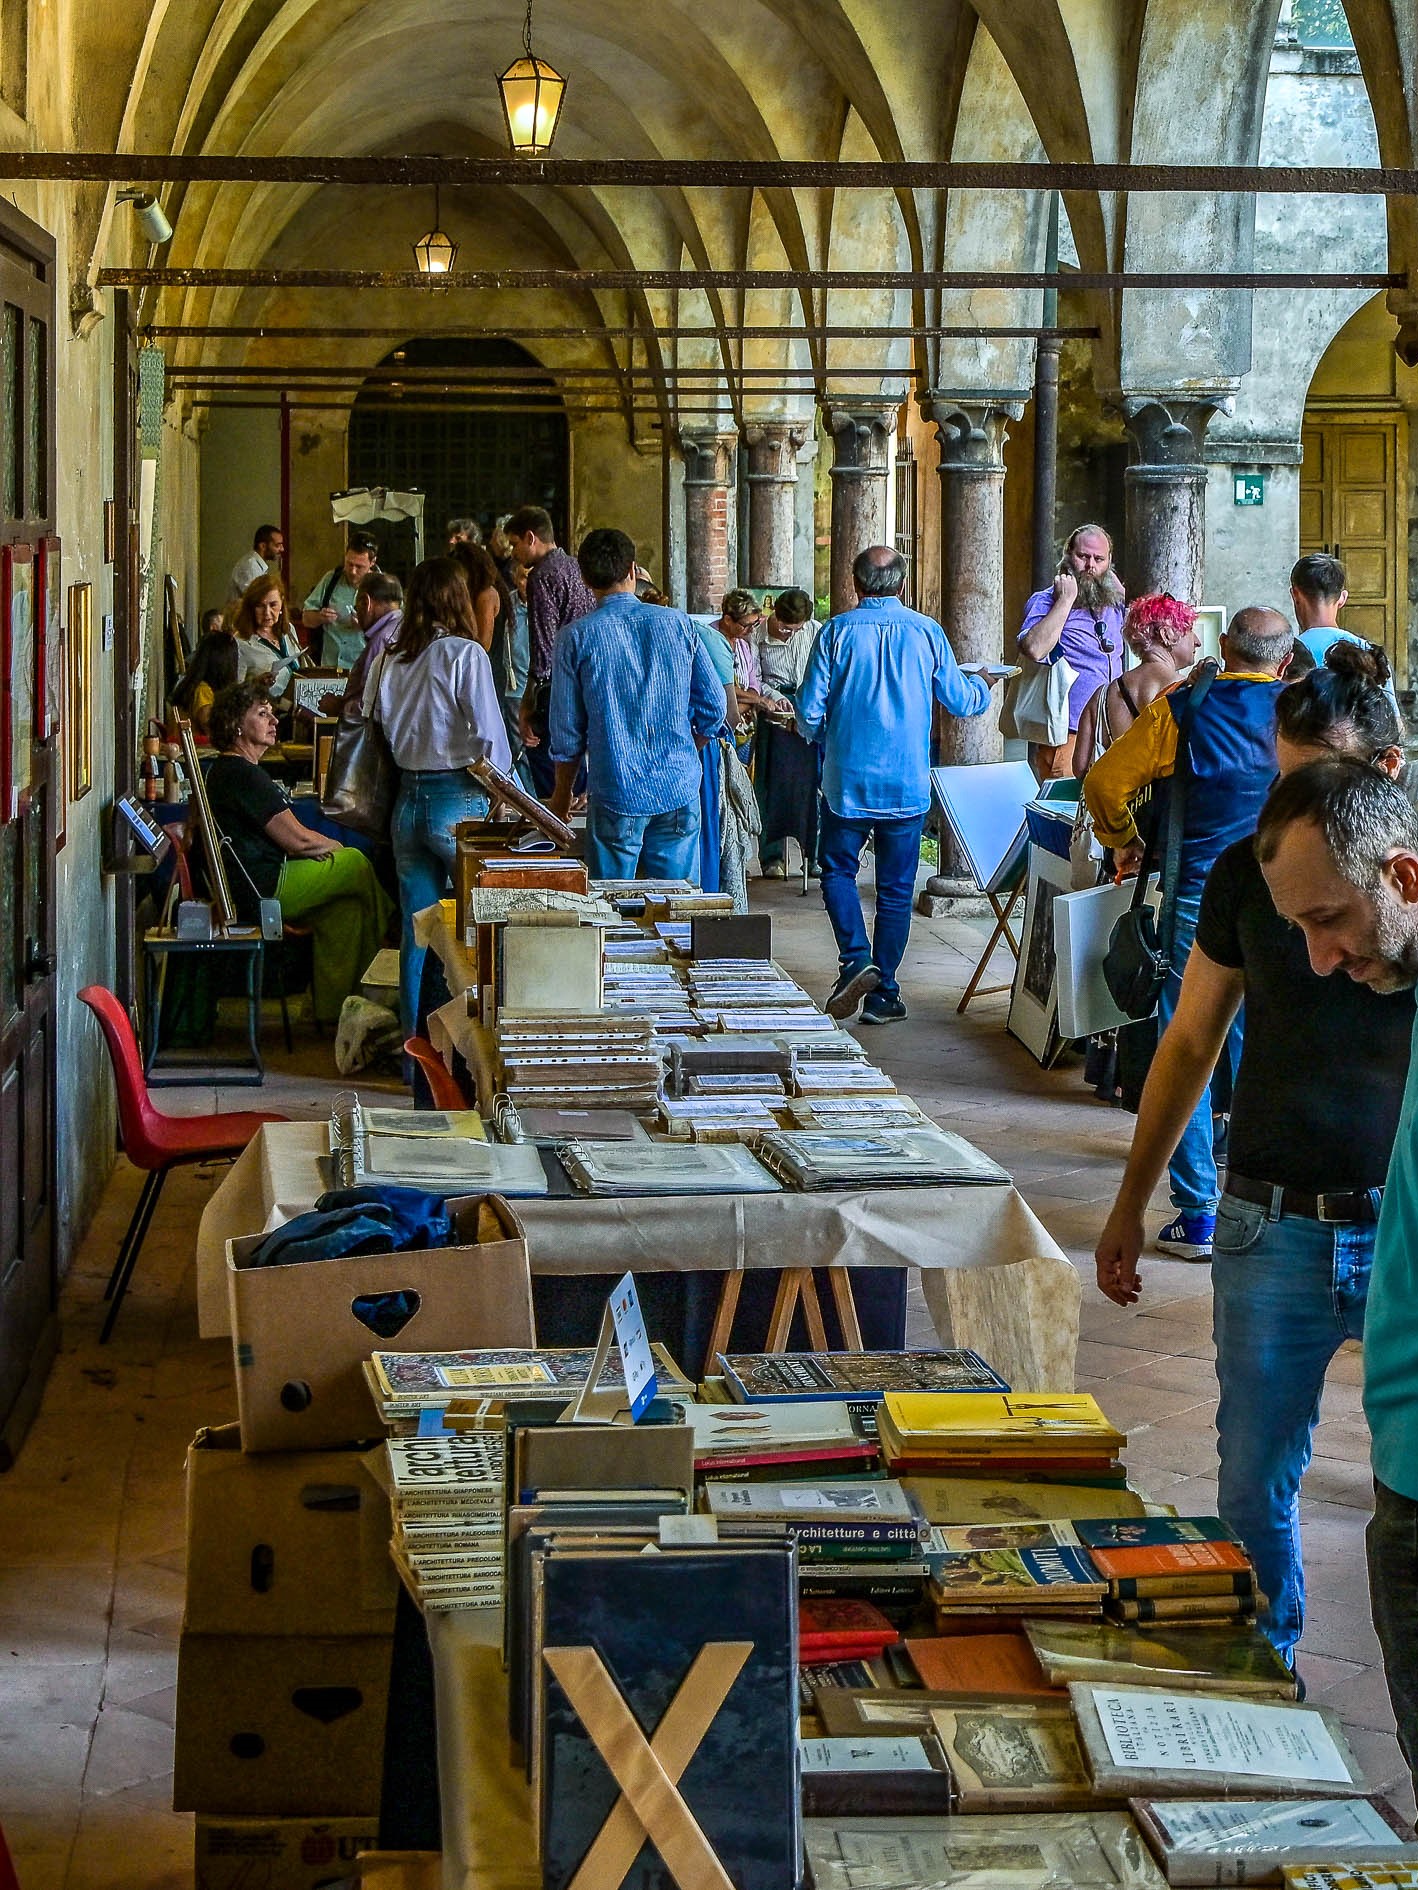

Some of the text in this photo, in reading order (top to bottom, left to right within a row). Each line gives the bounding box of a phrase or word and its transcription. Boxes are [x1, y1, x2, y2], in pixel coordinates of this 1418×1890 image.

[400, 1487, 494, 1497] L'ARCHITETTURA GIAPPONESE
[460, 1497, 495, 1505] MEDIEVALE
[407, 1531, 460, 1539] L'ARCHITETTURA
[787, 1523, 917, 1540] Architetture e città
[413, 1558, 465, 1566] L'ARCHITETTURA
[422, 1573, 471, 1581] L'ARCHITETTURA
[422, 1586, 471, 1595] L'ARCHITETTURA
[1106, 1698, 1139, 1760] BIBLIOTECA
[1126, 1706, 1147, 1751] ITALIANA
[1144, 1706, 1170, 1757] NOTIZIA
[1163, 1701, 1197, 1764] LIBRI RARI
